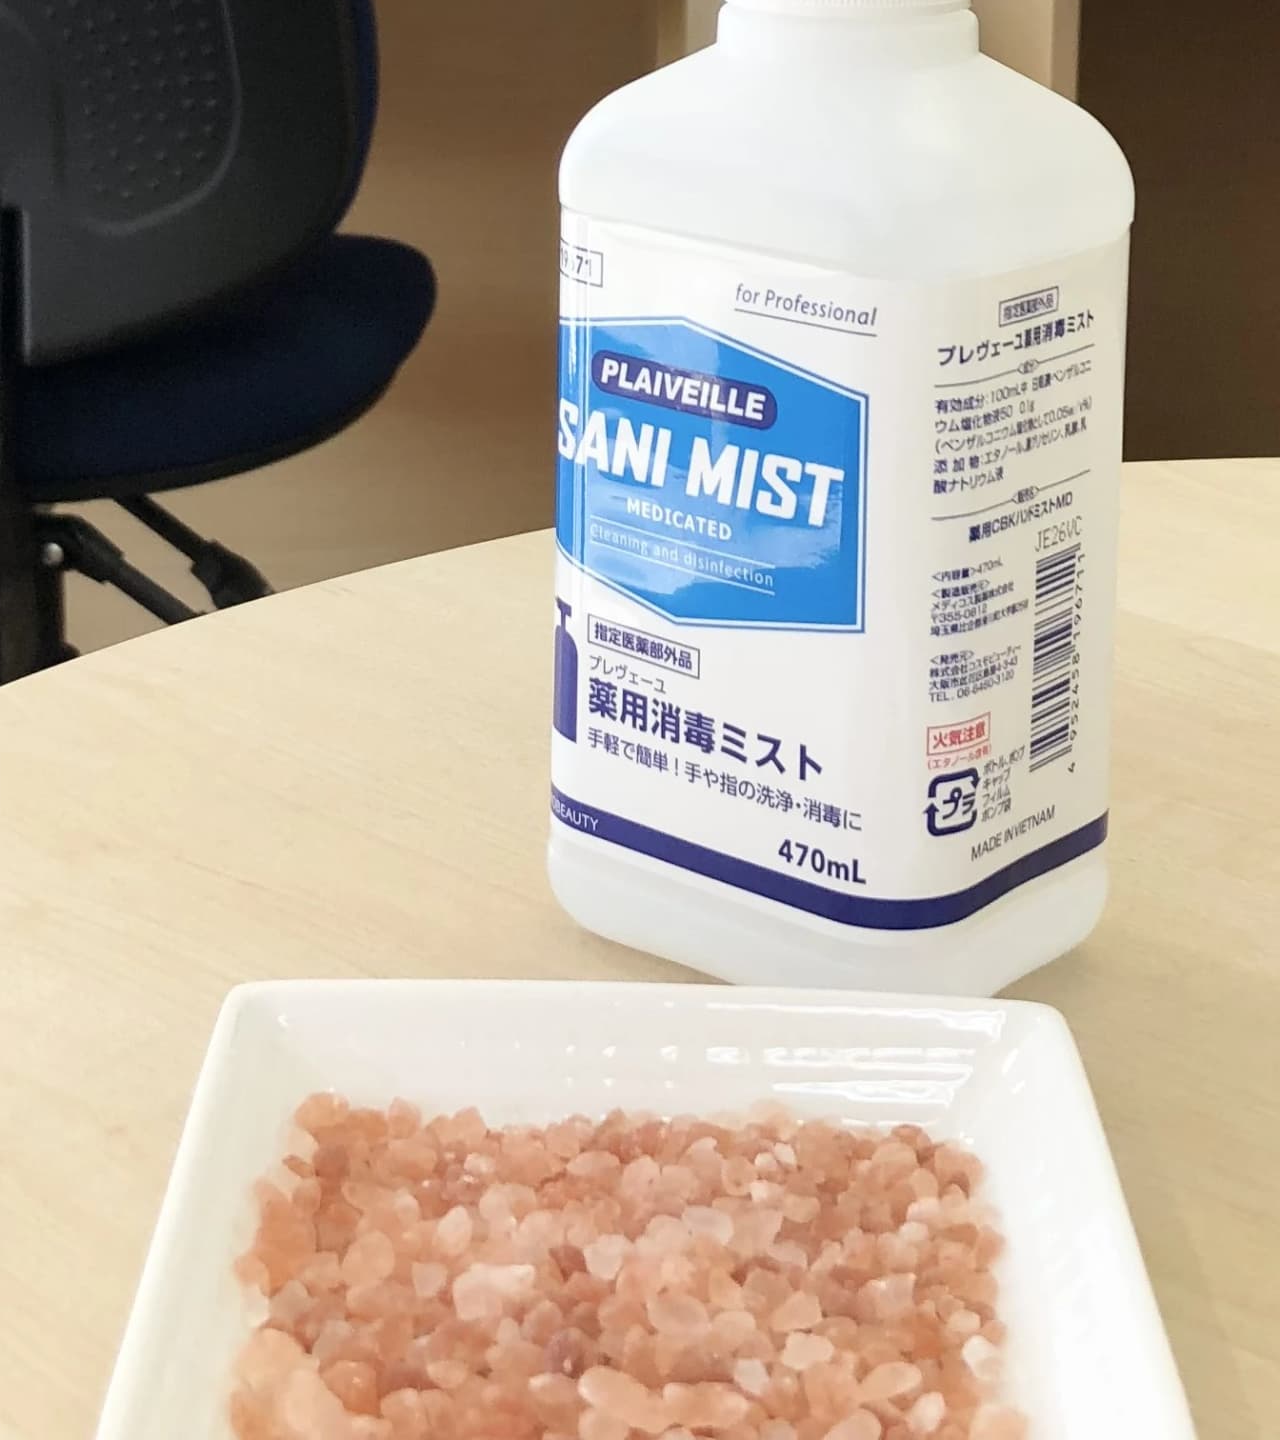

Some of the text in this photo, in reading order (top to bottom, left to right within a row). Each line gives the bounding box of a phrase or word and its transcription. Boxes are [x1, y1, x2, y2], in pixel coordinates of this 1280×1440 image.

[736, 283, 878, 326] for Professional
[601, 356, 766, 421] PLAIVEILLE
[558, 398, 845, 528] SANI MIST
[626, 496, 732, 541] MEDICATED
[590, 523, 774, 588] Cleaning and disinfection
[594, 621, 692, 671] 指定医薬部外品
[589, 655, 667, 694] プレヴェーユ
[588, 677, 823, 782] 薬用消毒ミスト
[933, 720, 986, 749] 火気注意
[942, 787, 976, 820] プラ
[971, 805, 1055, 861] MADE IN VIETNAM
[778, 838, 867, 885] 470mL
